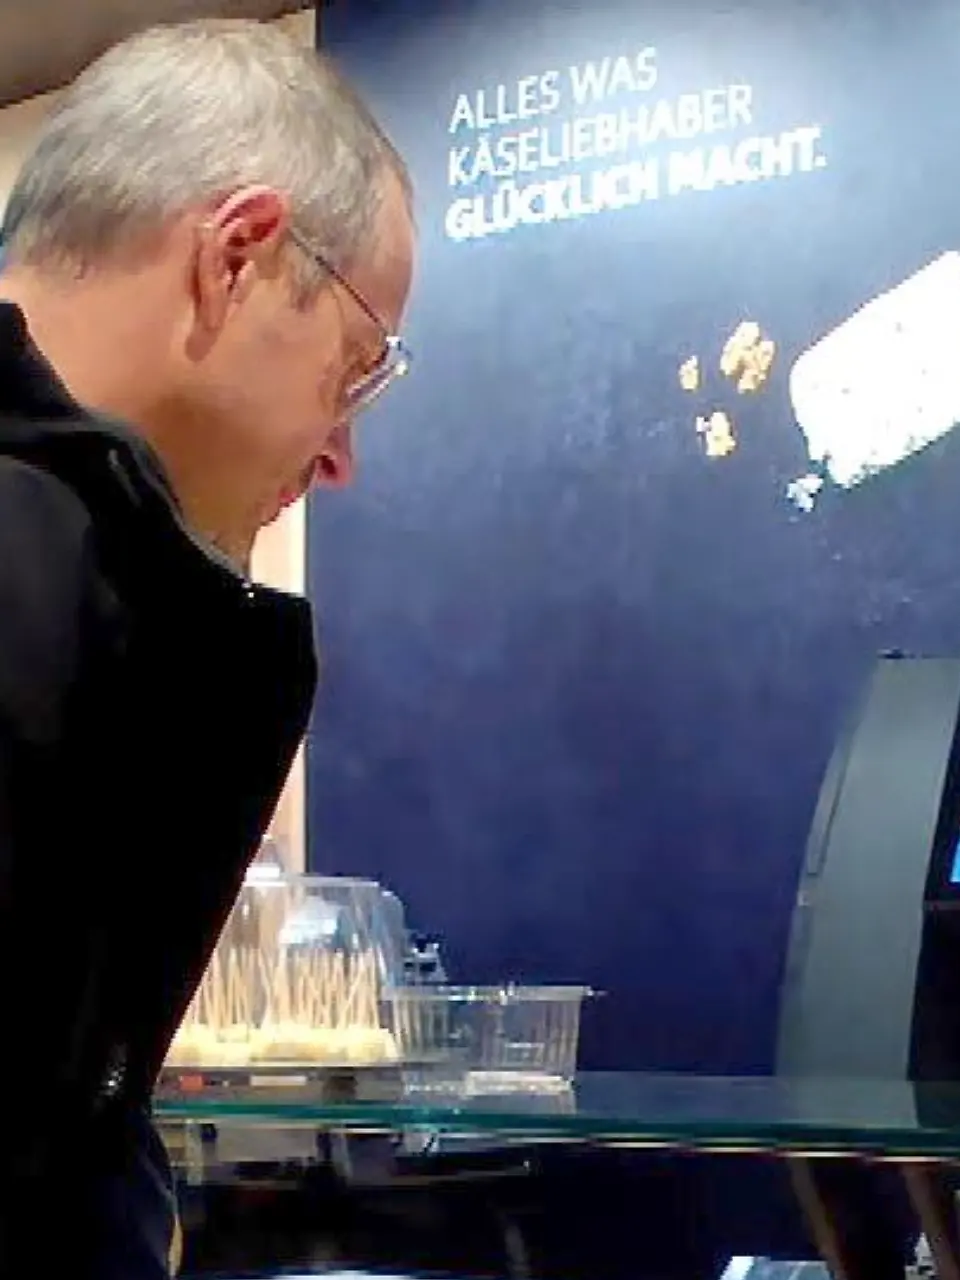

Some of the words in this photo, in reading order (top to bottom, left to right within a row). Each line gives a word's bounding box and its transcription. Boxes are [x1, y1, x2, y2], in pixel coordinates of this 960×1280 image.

[449, 71, 560, 133] ALLES
[569, 47, 658, 105] WAS
[449, 84, 753, 186] KÄSELIEBHABER
[445, 157, 659, 242] GLÜCKLICH
[667, 123, 828, 195] MACHT.
